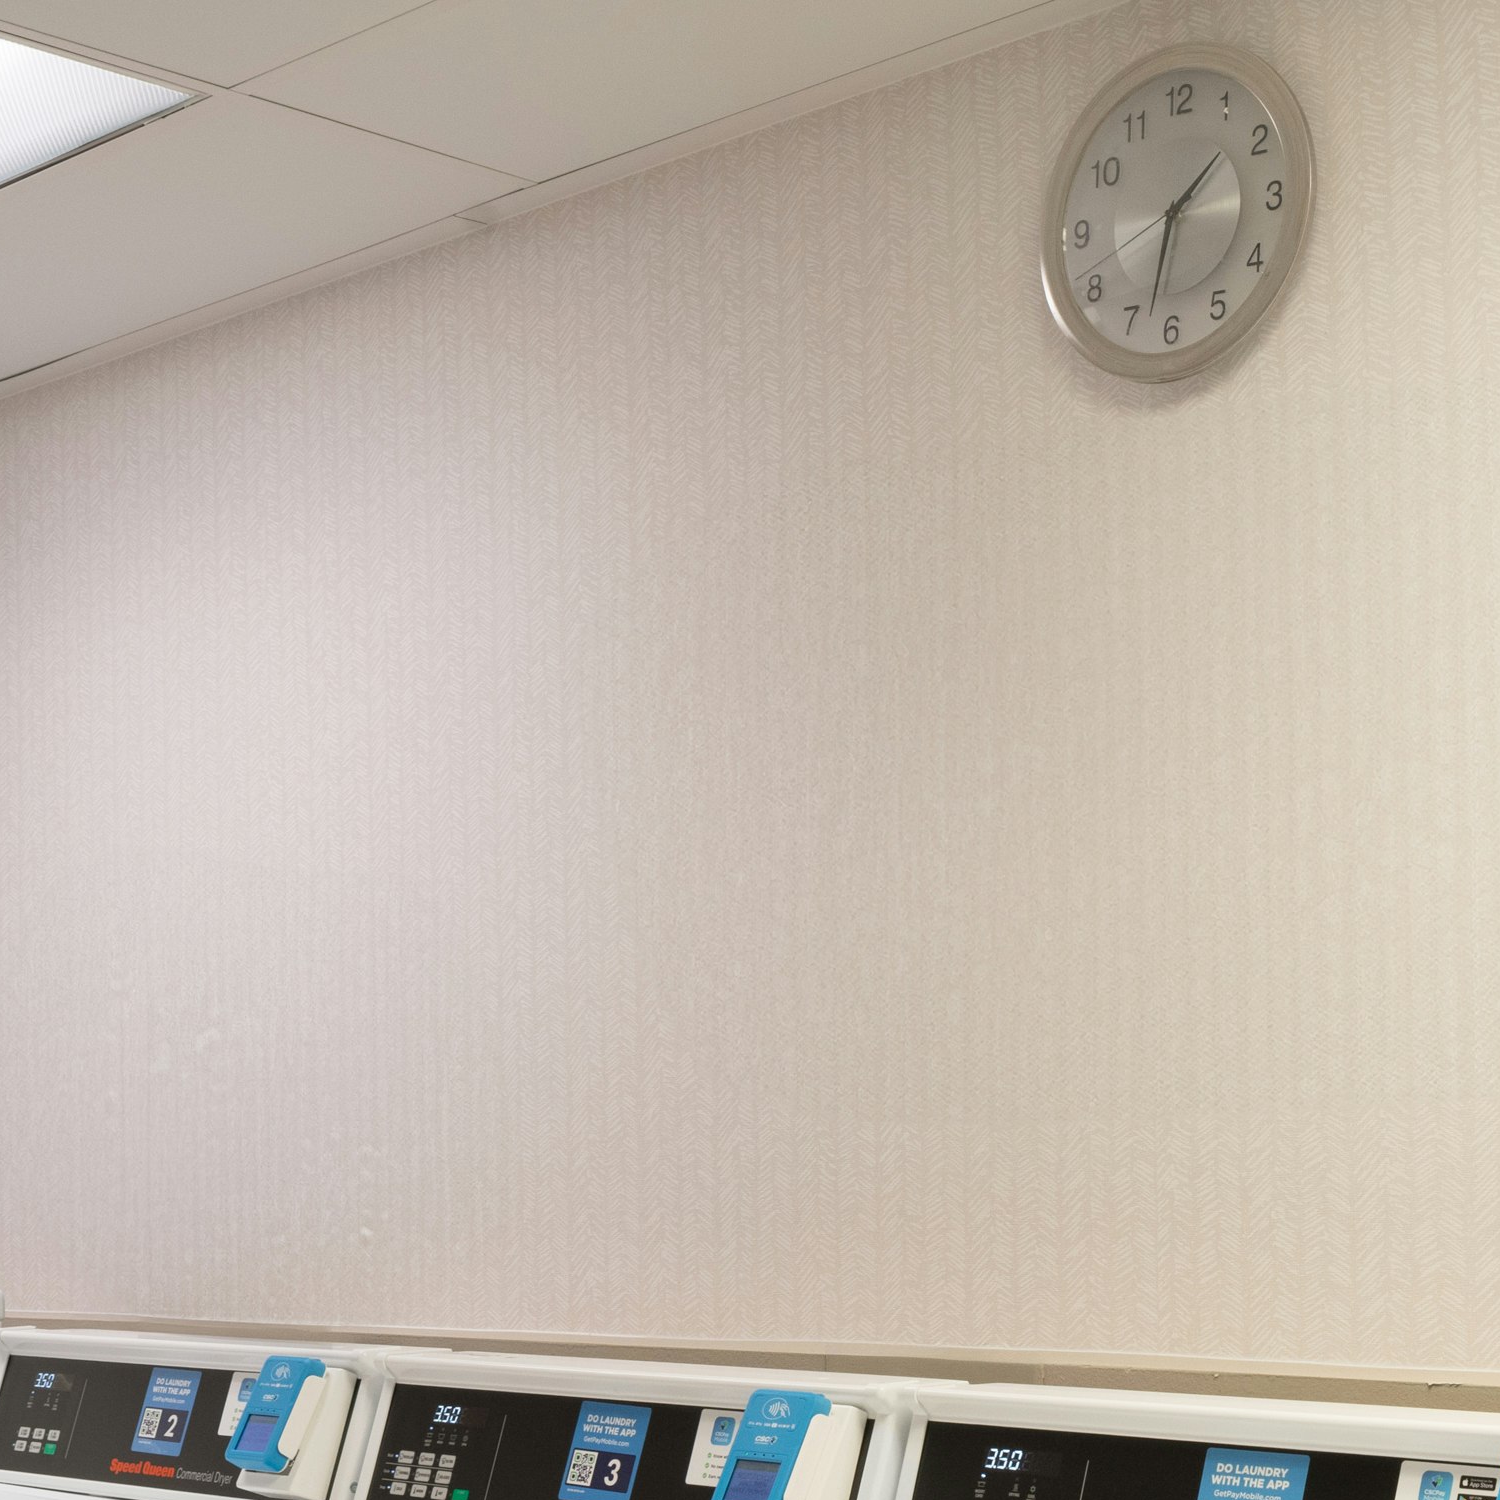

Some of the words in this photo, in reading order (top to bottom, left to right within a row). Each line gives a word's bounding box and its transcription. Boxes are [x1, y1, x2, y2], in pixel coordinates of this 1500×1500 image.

[1165, 83, 1193, 116] 12
[1220, 90, 1229, 121] 1
[1123, 109, 1146, 143] 11
[1251, 124, 1269, 156] 2
[1091, 156, 1121, 188] 10
[1265, 180, 1283, 210] 3
[1074, 220, 1090, 249] 9
[1246, 242, 1265, 273] 4
[1087, 274, 1102, 302] 8
[1209, 289, 1227, 320] 5
[1123, 304, 1140, 335] 7
[1163, 315, 1180, 344] 6
[165, 1379, 192, 1387] LAUNDRY
[179, 1388, 191, 1396] APP
[164, 1415, 177, 1437] 2
[583, 1424, 602, 1433] WITH
[605, 1427, 619, 1435] THE
[620, 1428, 636, 1437] APP
[587, 1414, 599, 1422] DO
[600, 1416, 636, 1426] LAUNDRY
[110, 1458, 142, 1475] Speed
[143, 1461, 175, 1477] Queen
[177, 1467, 213, 1482] Commercial
[214, 1472, 233, 1486] Dryer
[604, 1459, 621, 1486] 3
[985, 1448, 1023, 1470] 3.50
[1216, 1463, 1233, 1473] DO
[1236, 1465, 1288, 1478] LAUNDRY
[1212, 1475, 1240, 1486] WITH
[1243, 1478, 1265, 1488] THE
[1266, 1480, 1290, 1490] APP
